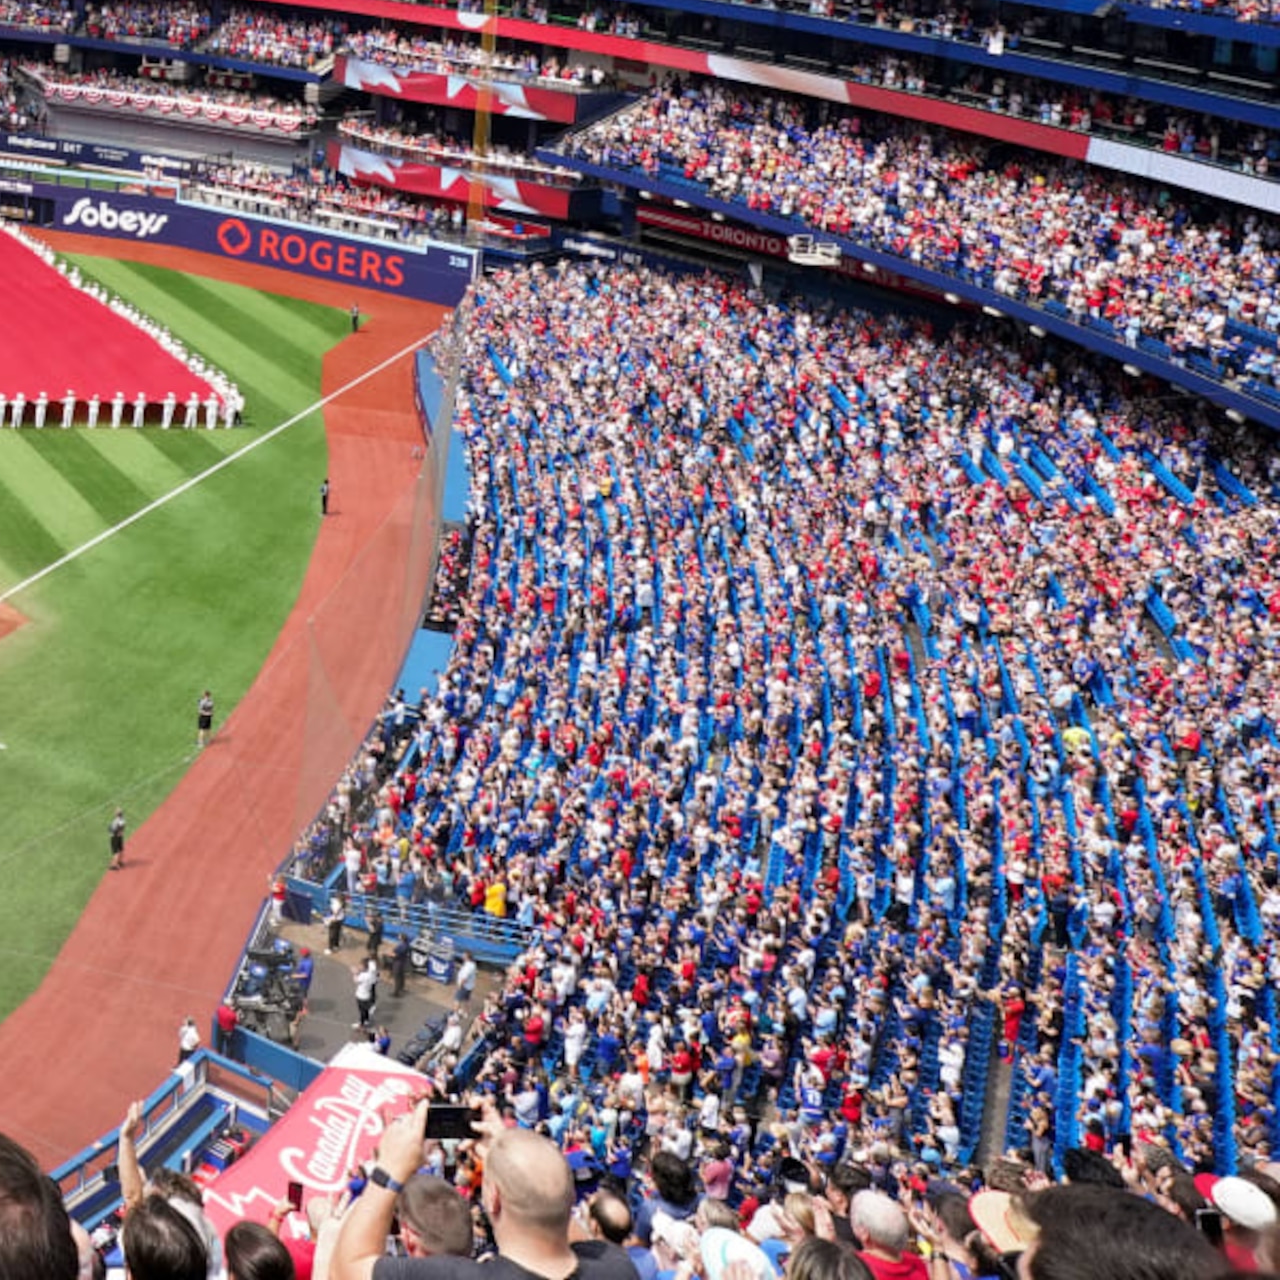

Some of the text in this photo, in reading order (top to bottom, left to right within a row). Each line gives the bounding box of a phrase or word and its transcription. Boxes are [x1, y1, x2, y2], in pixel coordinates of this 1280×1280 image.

[63, 198, 168, 238] Sobeys
[703, 222, 782, 254] TORONTO
[259, 228, 406, 287] ROGERS
[279, 1114, 354, 1192] Canada
